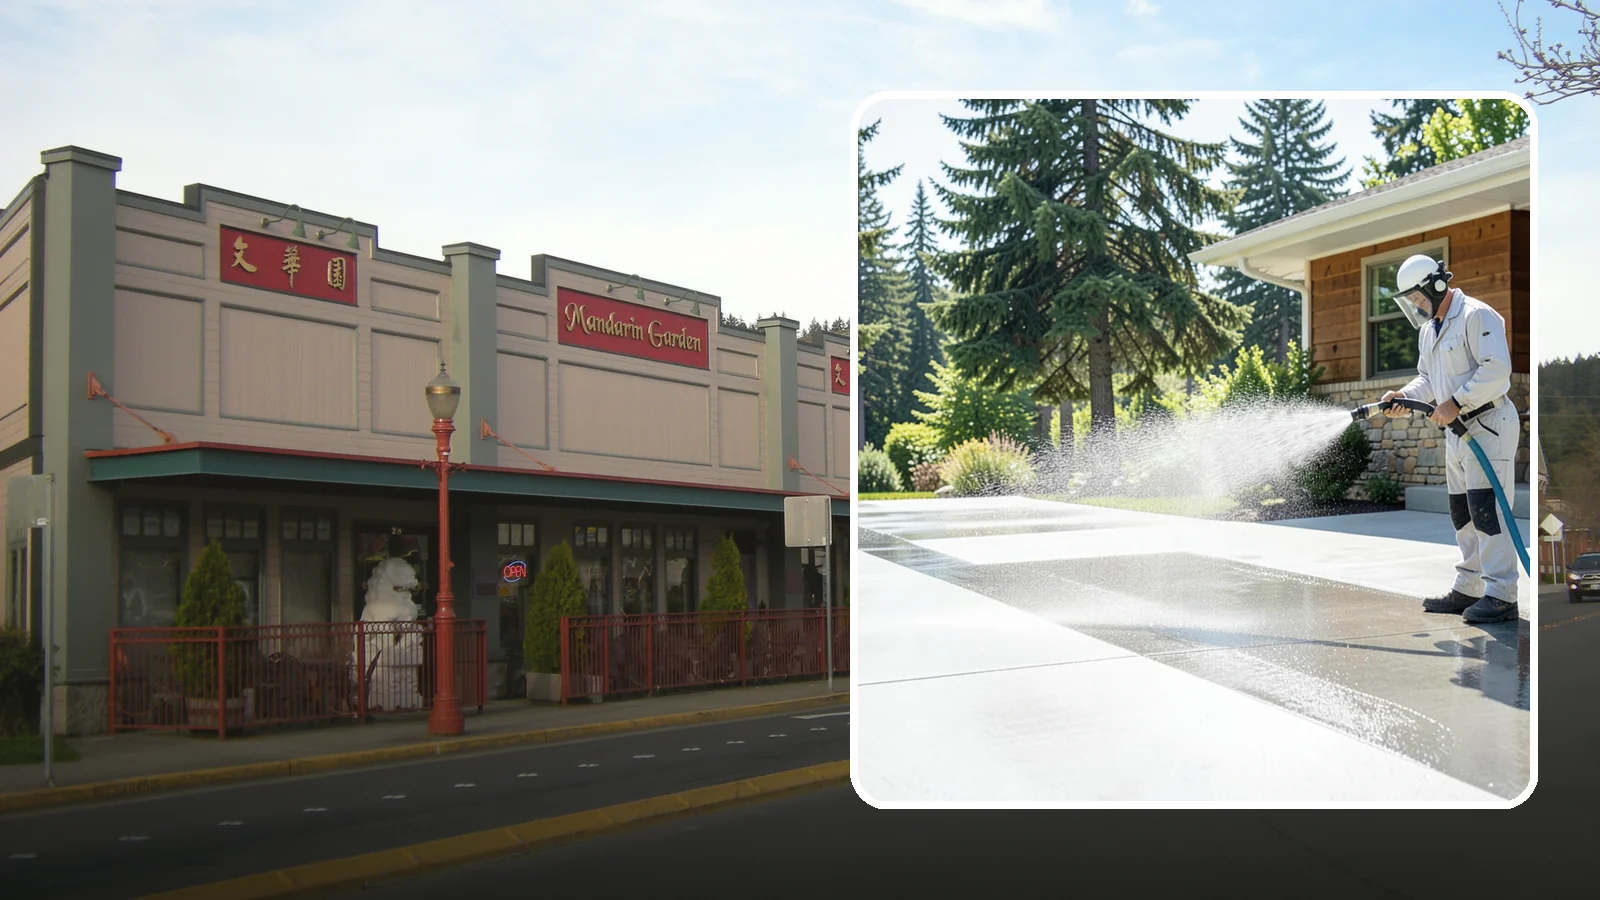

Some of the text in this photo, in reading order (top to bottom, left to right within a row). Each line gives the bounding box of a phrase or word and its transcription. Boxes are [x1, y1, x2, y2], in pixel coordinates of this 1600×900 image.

[564, 302, 701, 352] Mandarin Garden
[503, 565, 527, 578] OPEN
